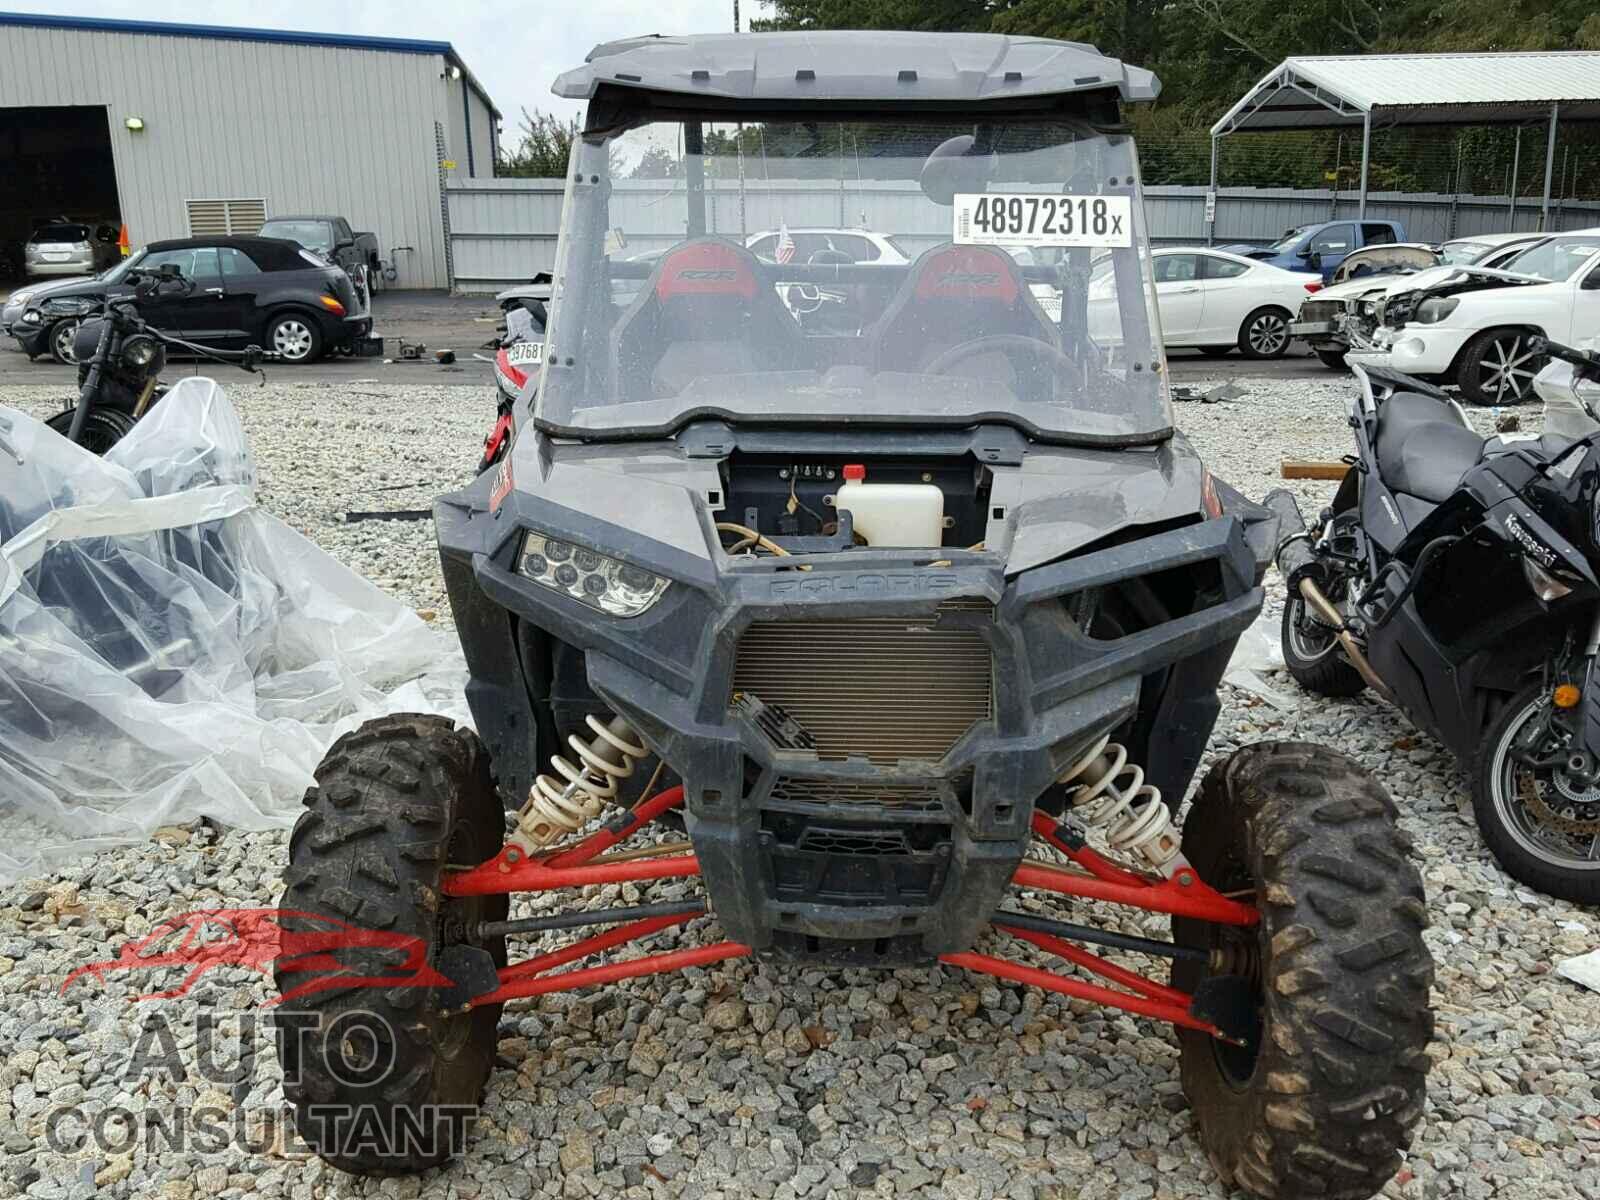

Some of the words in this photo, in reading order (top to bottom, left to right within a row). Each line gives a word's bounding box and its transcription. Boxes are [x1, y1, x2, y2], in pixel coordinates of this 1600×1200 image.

[974, 197, 1108, 235] 48972318
[1504, 513, 1557, 567] Kawasaki
[769, 574, 958, 598] POLARIS
